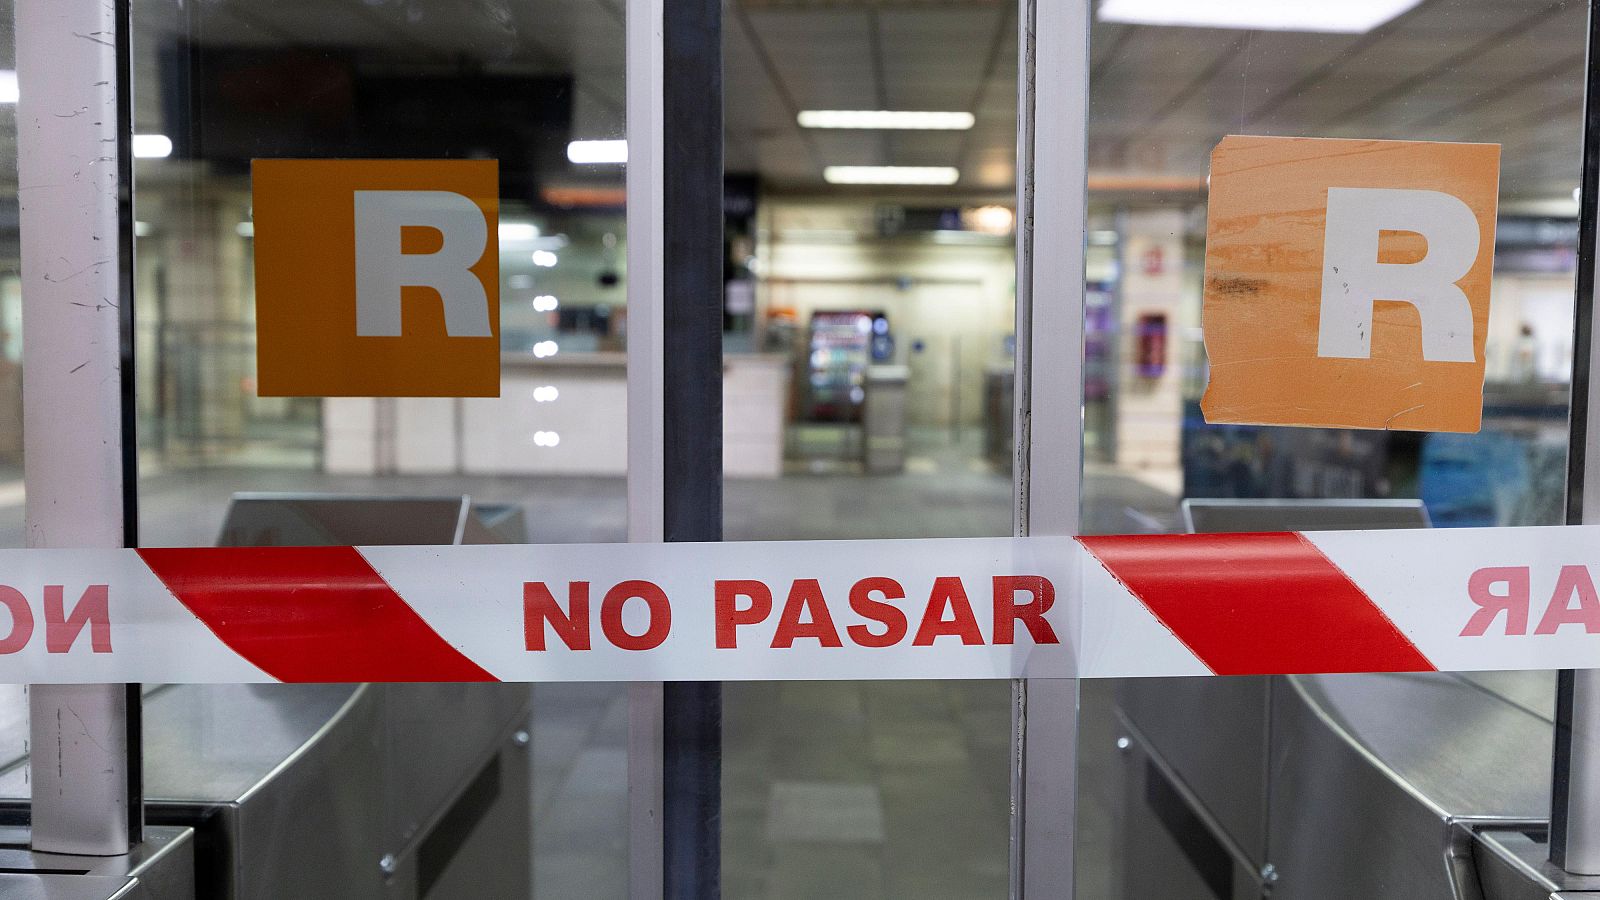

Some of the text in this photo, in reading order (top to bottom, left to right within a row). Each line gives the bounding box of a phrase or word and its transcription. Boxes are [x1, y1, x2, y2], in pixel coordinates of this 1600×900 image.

[354, 190, 493, 338] R
[1317, 187, 1481, 363] R
[523, 575, 1060, 652] NO PASAR
